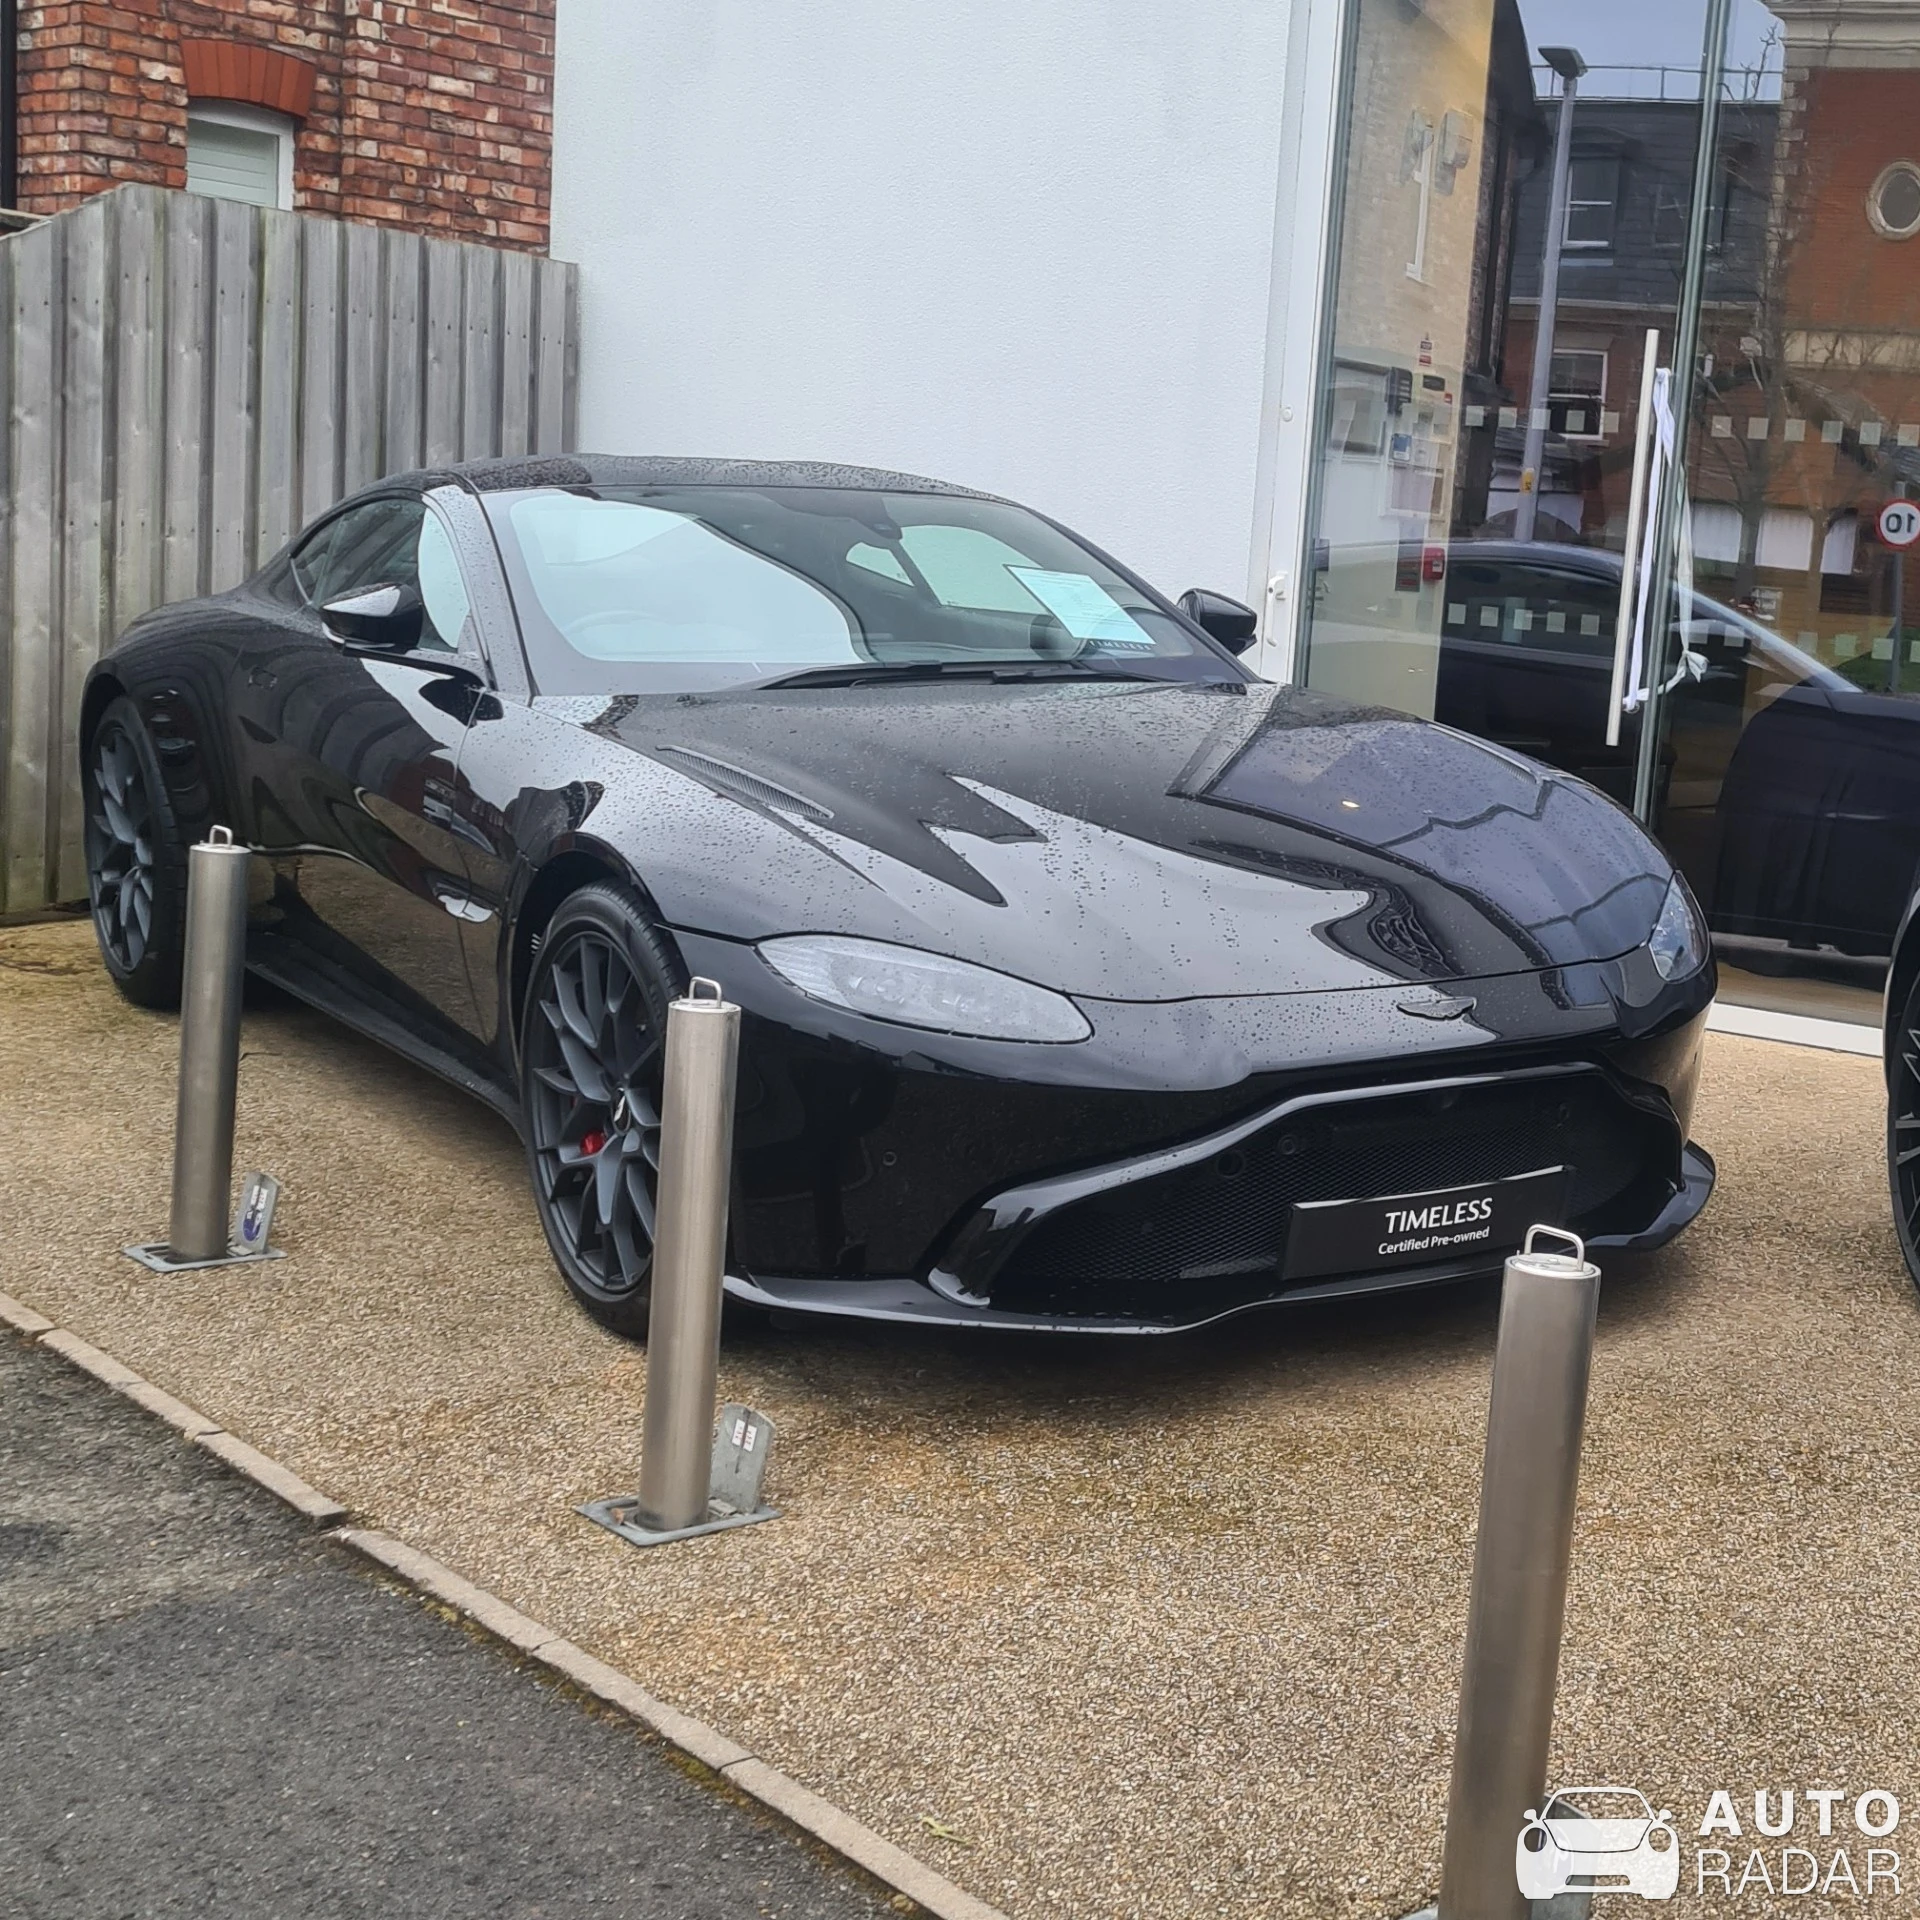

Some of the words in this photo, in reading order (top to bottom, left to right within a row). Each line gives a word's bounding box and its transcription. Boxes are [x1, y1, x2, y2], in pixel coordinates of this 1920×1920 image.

[1386, 1198, 1493, 1233] TIMELESS
[1378, 1236, 1430, 1255] Certified
[1430, 1226, 1490, 1247] Pre-owned
